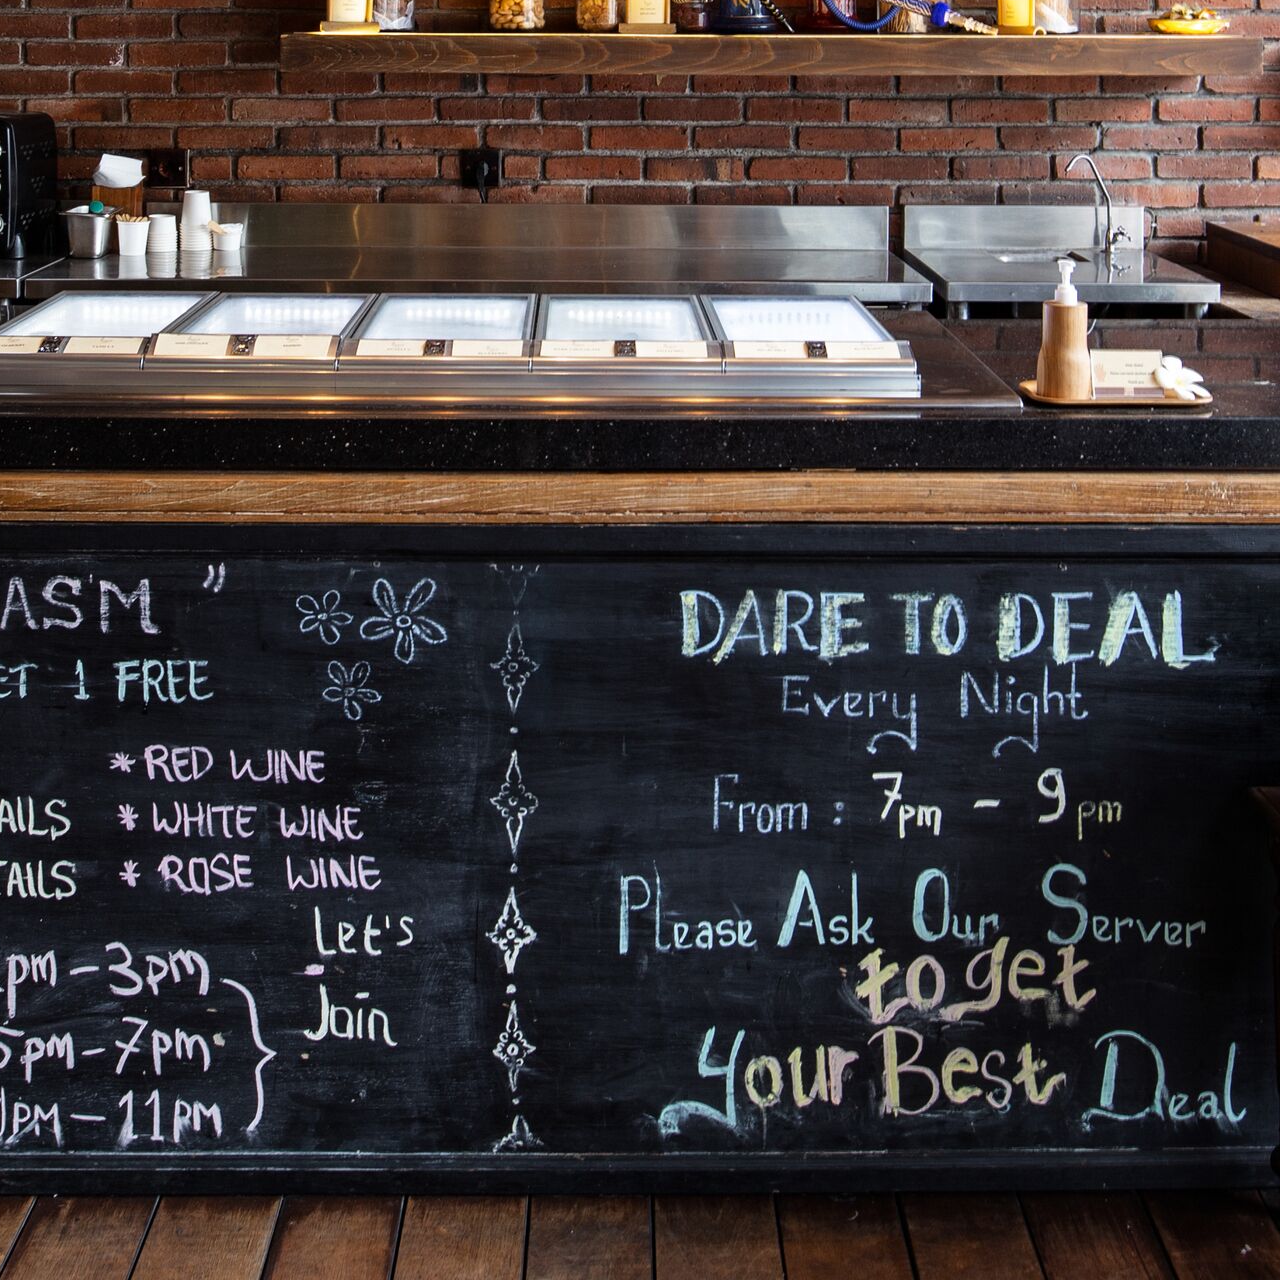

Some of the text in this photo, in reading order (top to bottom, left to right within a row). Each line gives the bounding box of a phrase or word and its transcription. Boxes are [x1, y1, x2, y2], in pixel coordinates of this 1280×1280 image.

[680, 589, 1218, 668] DARE TO DEAL
[75, 659, 89, 700] 1
[115, 659, 213, 705] FREE
[781, 664, 1088, 757] Every Night
[145, 745, 325, 784] RED WINE
[153, 803, 364, 843] WHITE WINE
[713, 774, 808, 833] From
[872, 771, 941, 838] 7pm
[158, 854, 382, 895] ROSE WINE
[314, 906, 413, 957] Let's
[619, 860, 1206, 955] Please Ask Our Server
[659, 1025, 1246, 1138] Your Best Deal
